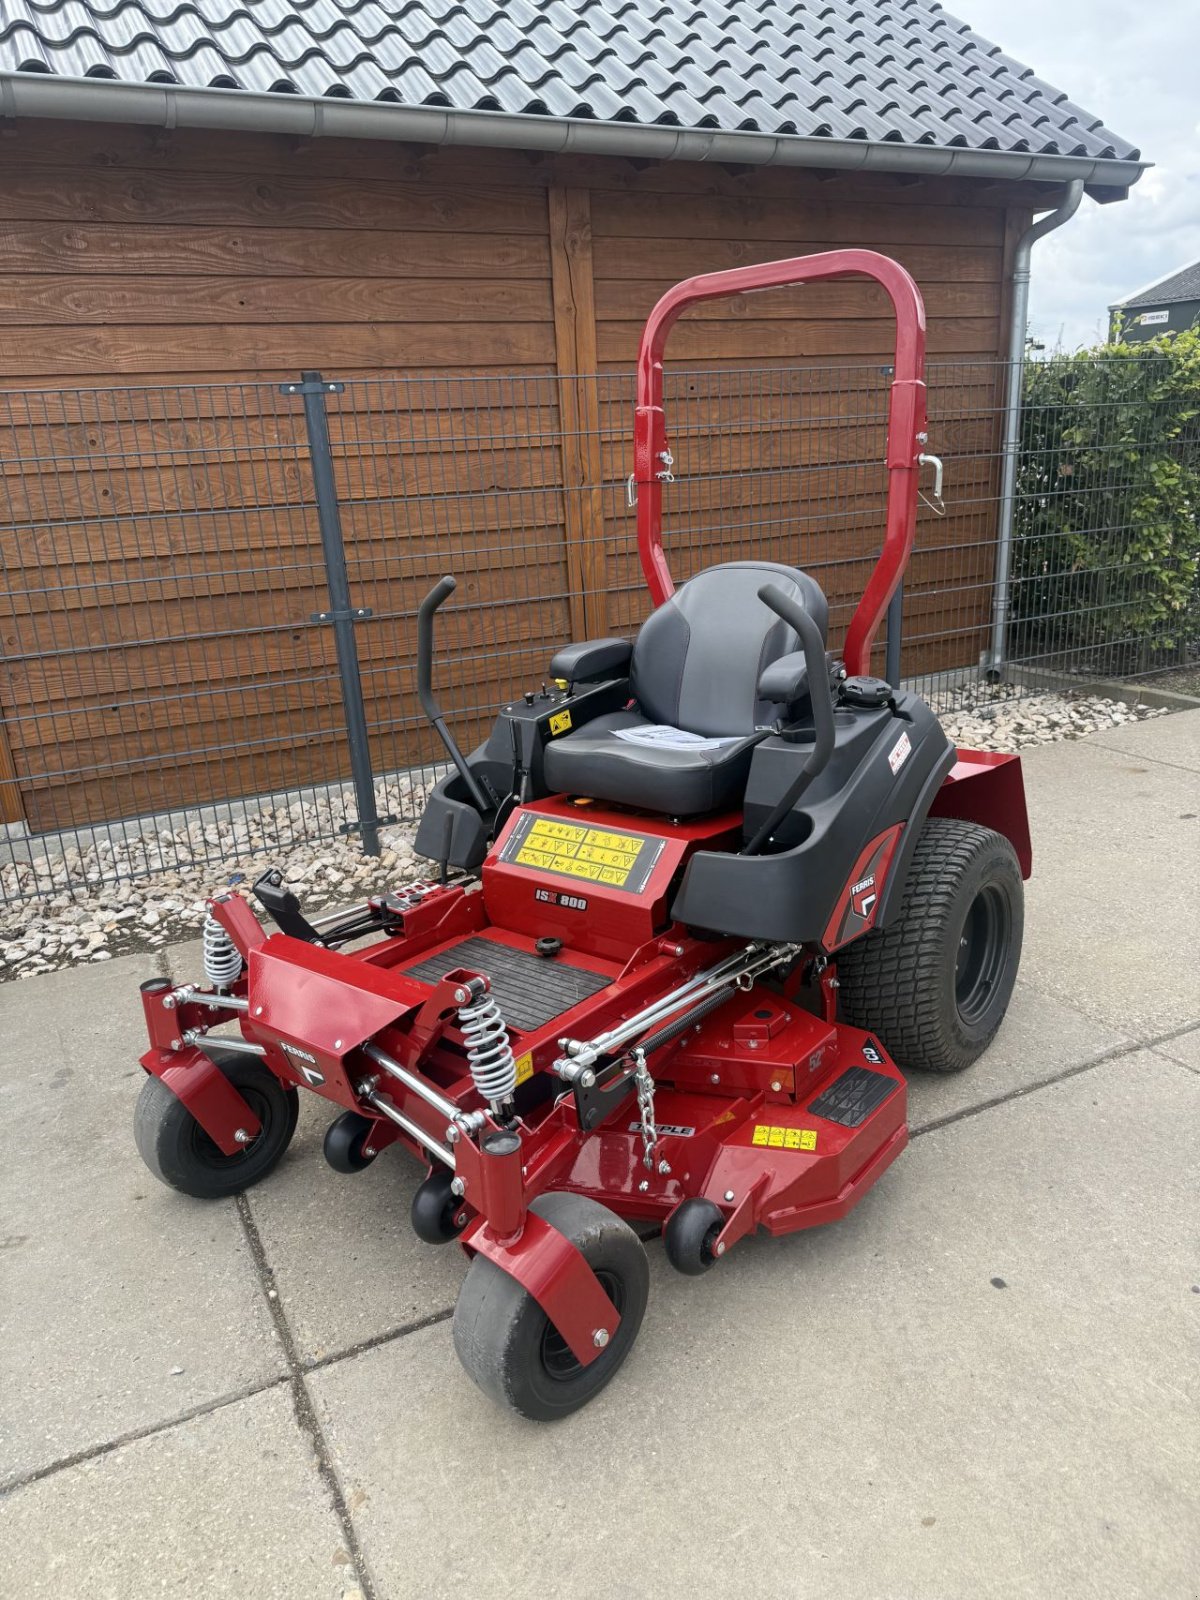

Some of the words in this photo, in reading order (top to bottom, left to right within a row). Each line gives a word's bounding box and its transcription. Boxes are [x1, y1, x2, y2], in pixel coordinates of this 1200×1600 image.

[851, 876, 874, 895] FERRIS
[535, 889, 557, 903] ISX
[560, 895, 587, 910] 800
[281, 1041, 316, 1063] FERRIS
[635, 1124, 693, 1135] TIPLE
